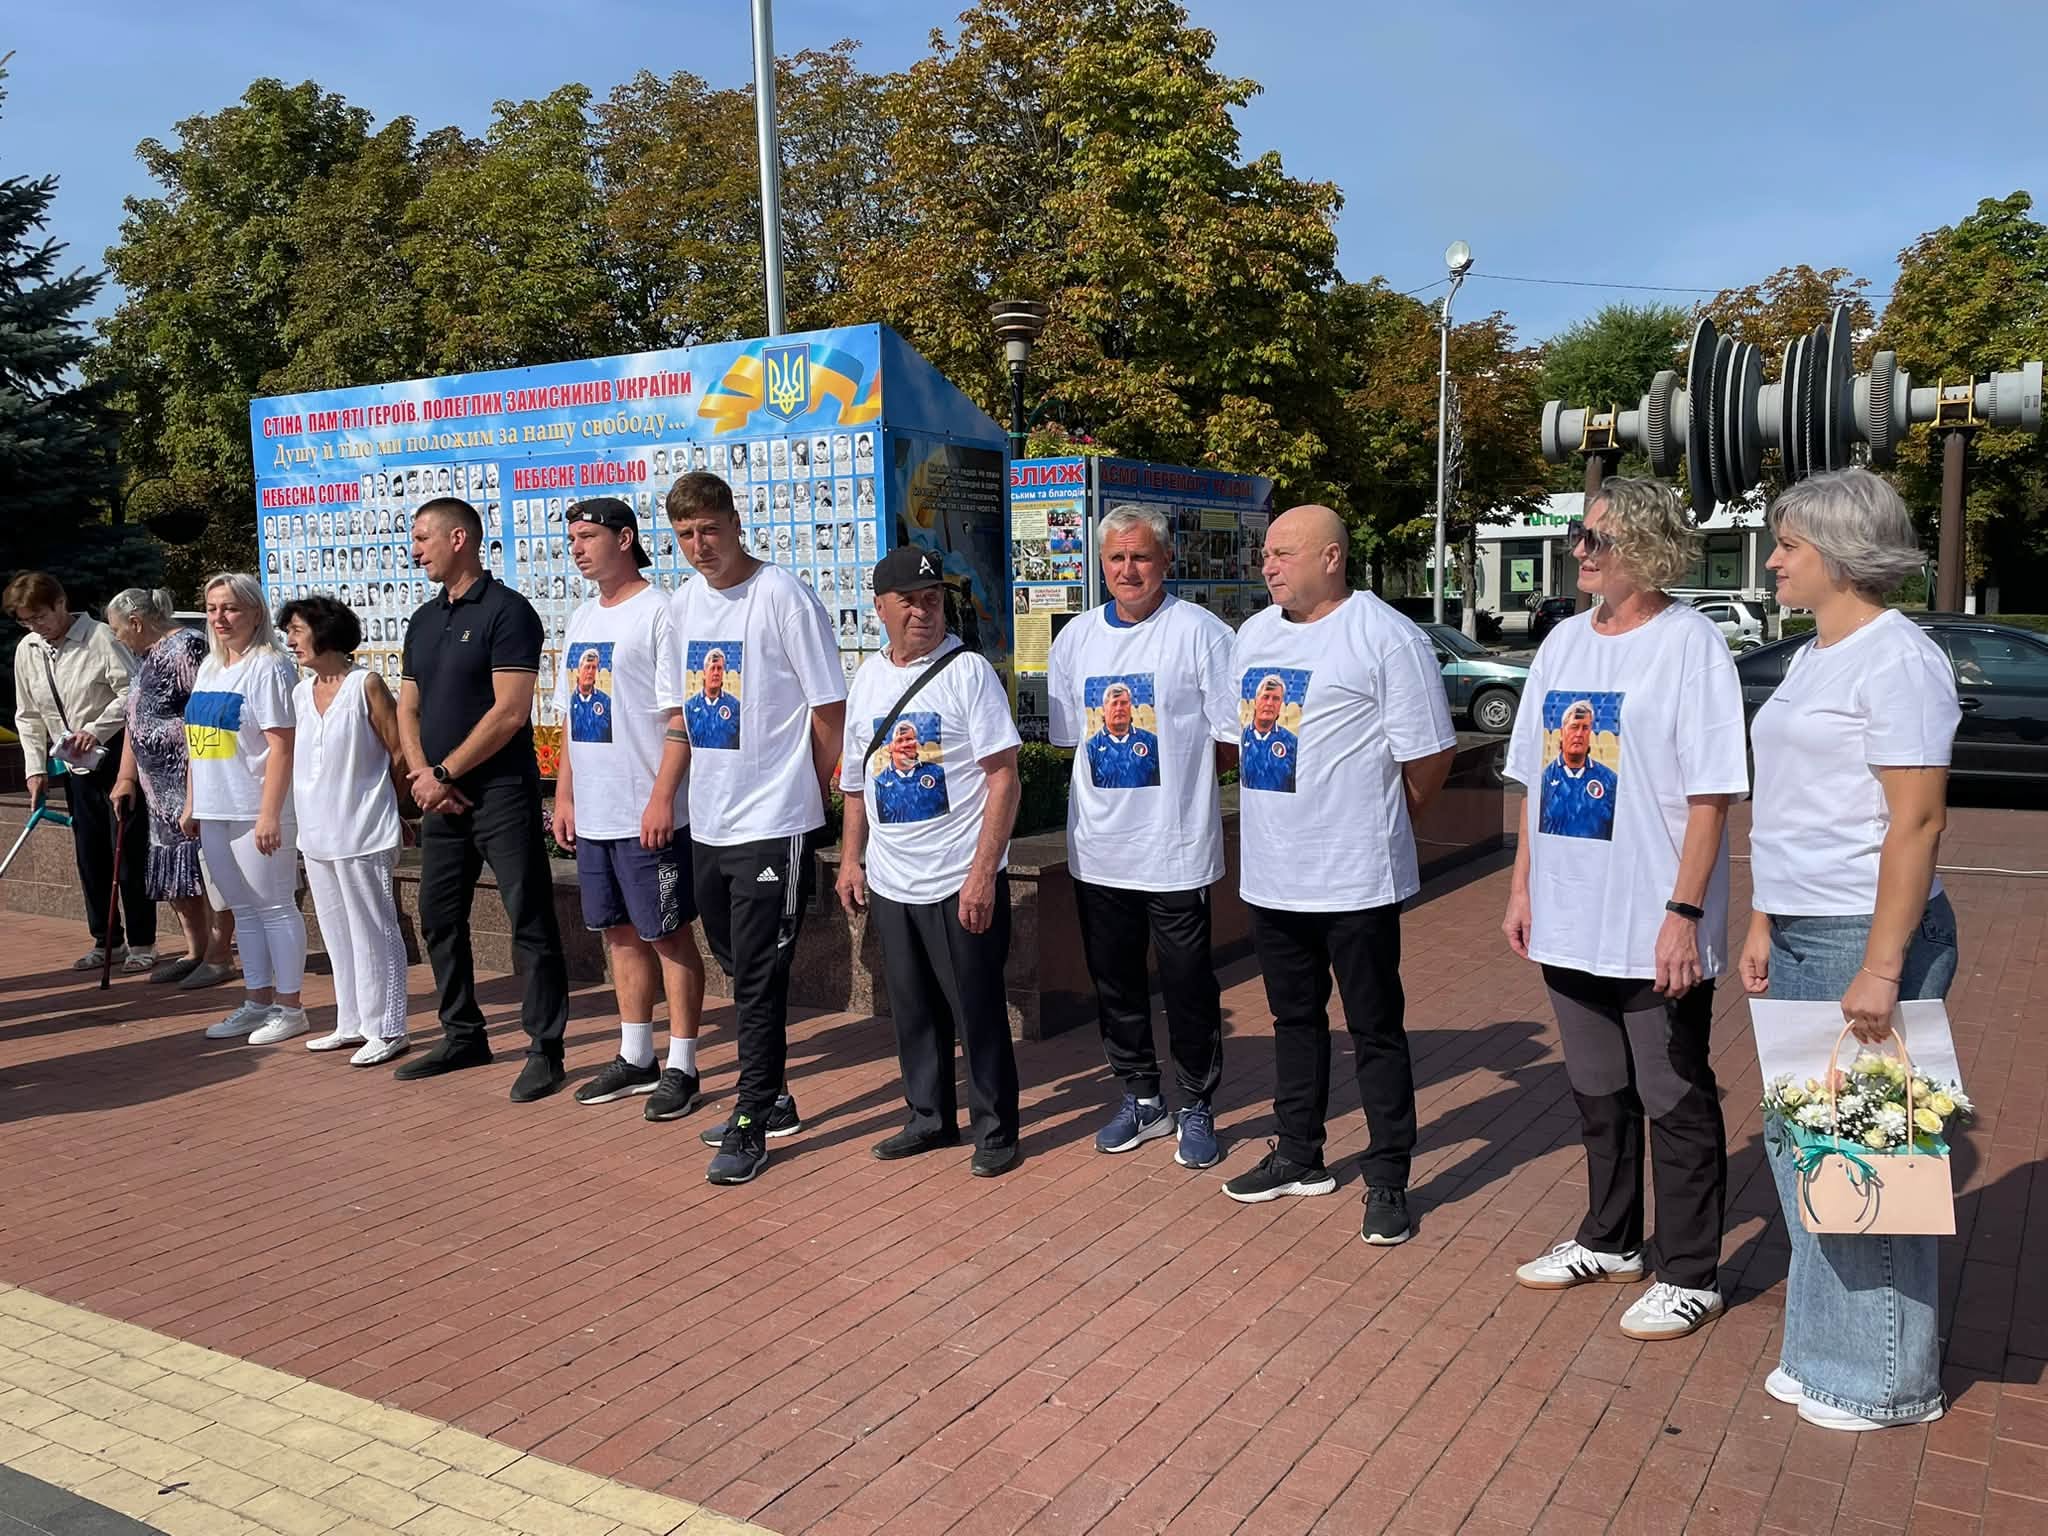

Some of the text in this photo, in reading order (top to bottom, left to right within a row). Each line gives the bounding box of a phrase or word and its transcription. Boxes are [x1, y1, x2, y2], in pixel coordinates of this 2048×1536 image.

[263, 369, 692, 438] СТІНА ПАМ'ЯТІ ГЕРОЇВ, ПОЛЕГЛИХ ЗАХИСНИКІВ УКРАЇНИ
[273, 409, 687, 470] Душу й тіло ми положим за нашу свободу...
[513, 464, 575, 491] НЕБЕСНЕ
[580, 458, 648, 489] ВІЙСЬКО
[263, 482, 360, 509] НЕБЕСНА СОТНЯ
[919, 555, 935, 575] A
